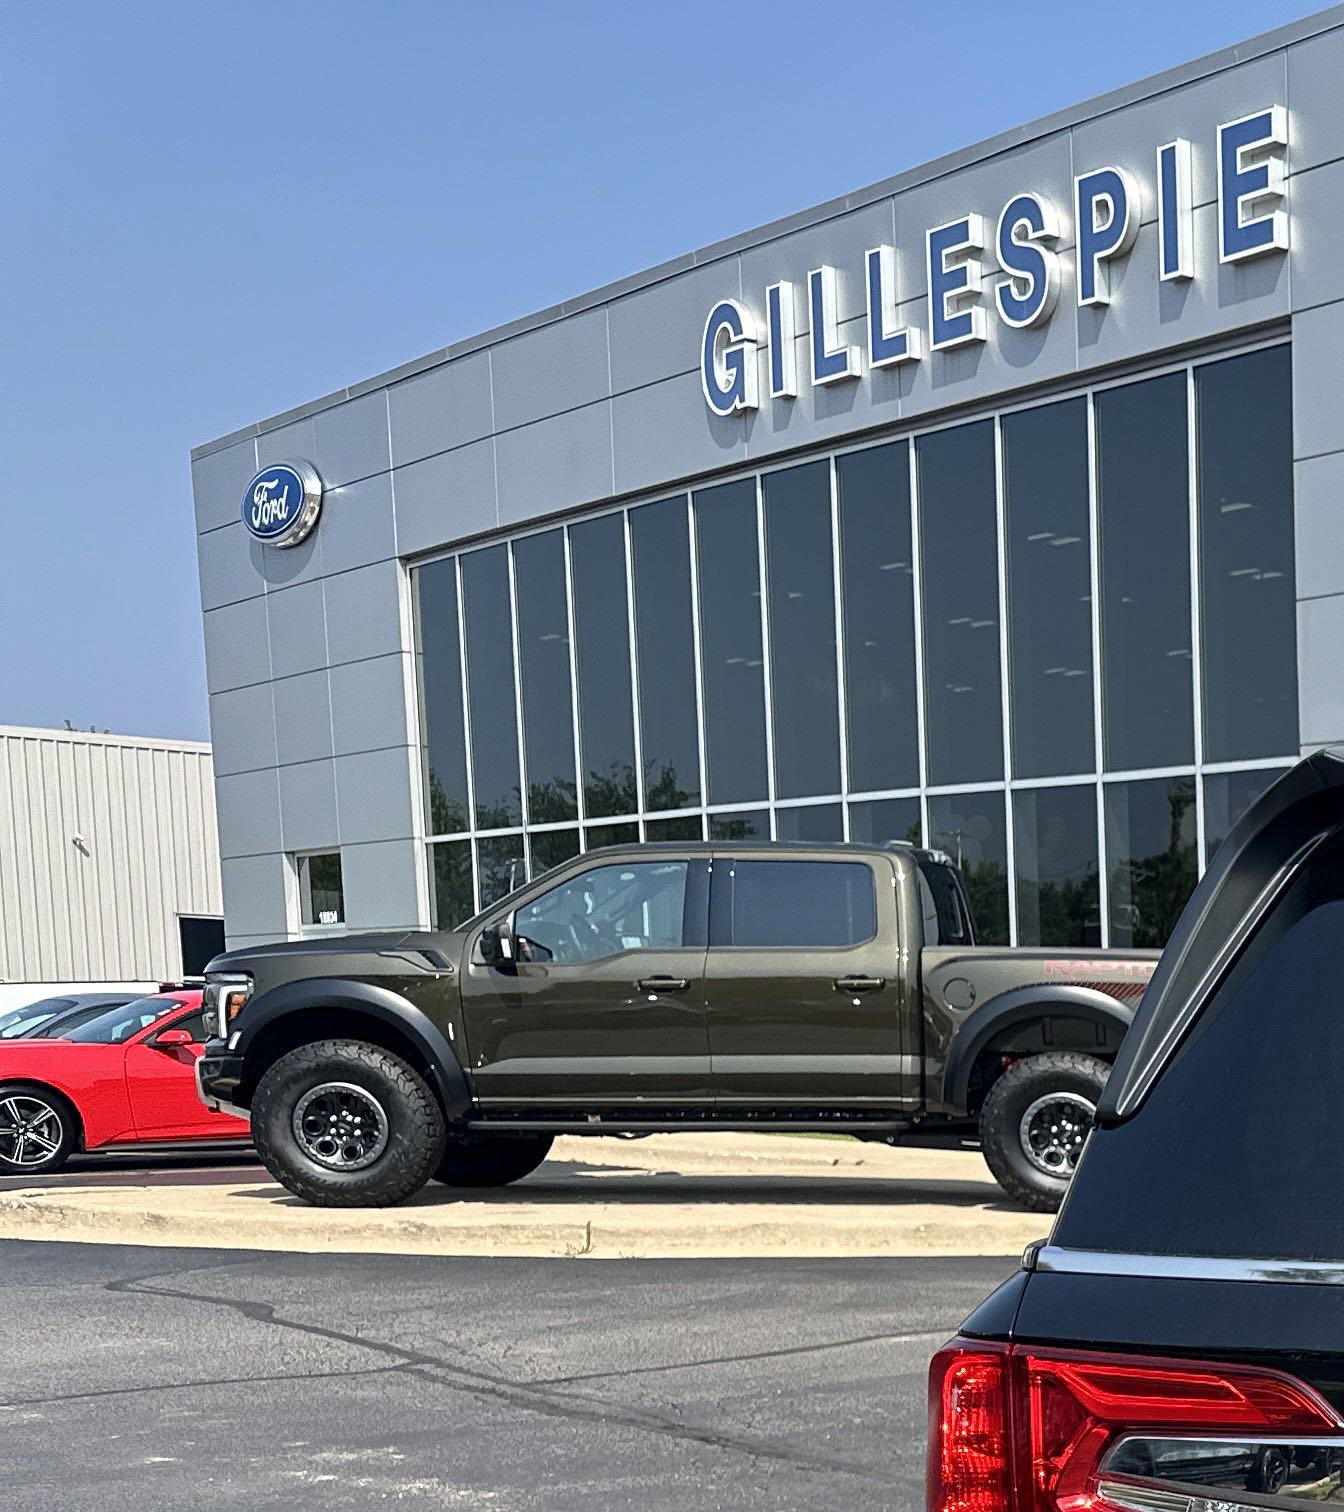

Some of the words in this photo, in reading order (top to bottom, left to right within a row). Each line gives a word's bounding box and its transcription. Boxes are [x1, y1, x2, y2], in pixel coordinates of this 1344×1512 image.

[701, 104, 1289, 417] GILLESPIE
[251, 478, 290, 529] Ford
[1043, 959, 1159, 979] RAPTO
